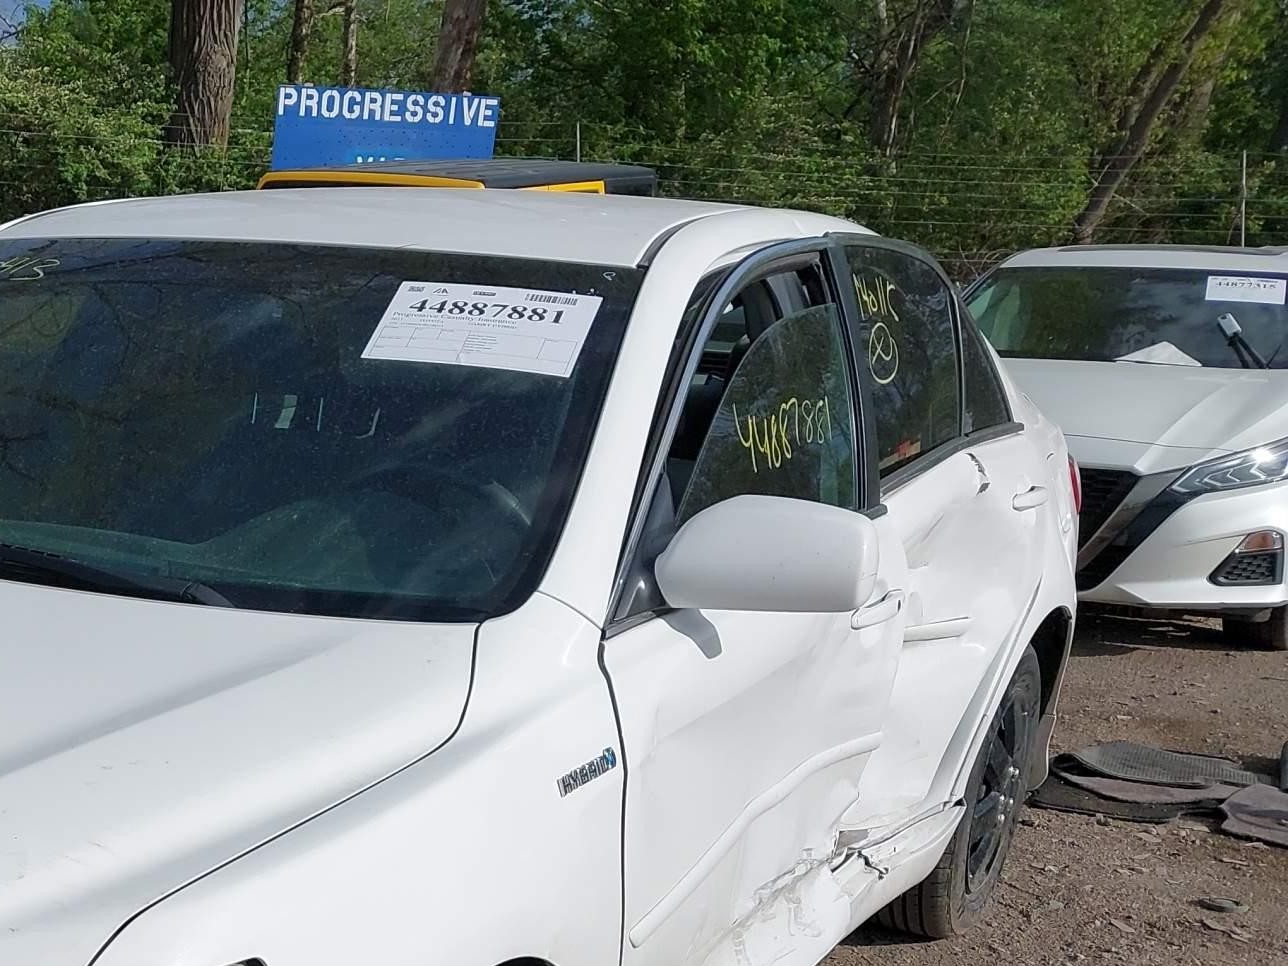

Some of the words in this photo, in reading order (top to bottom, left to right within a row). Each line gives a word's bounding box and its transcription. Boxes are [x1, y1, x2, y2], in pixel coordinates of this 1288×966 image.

[277, 86, 499, 127] PROGRESSIVE
[408, 298, 566, 325] 44887881
[732, 395, 833, 474] 44887881
